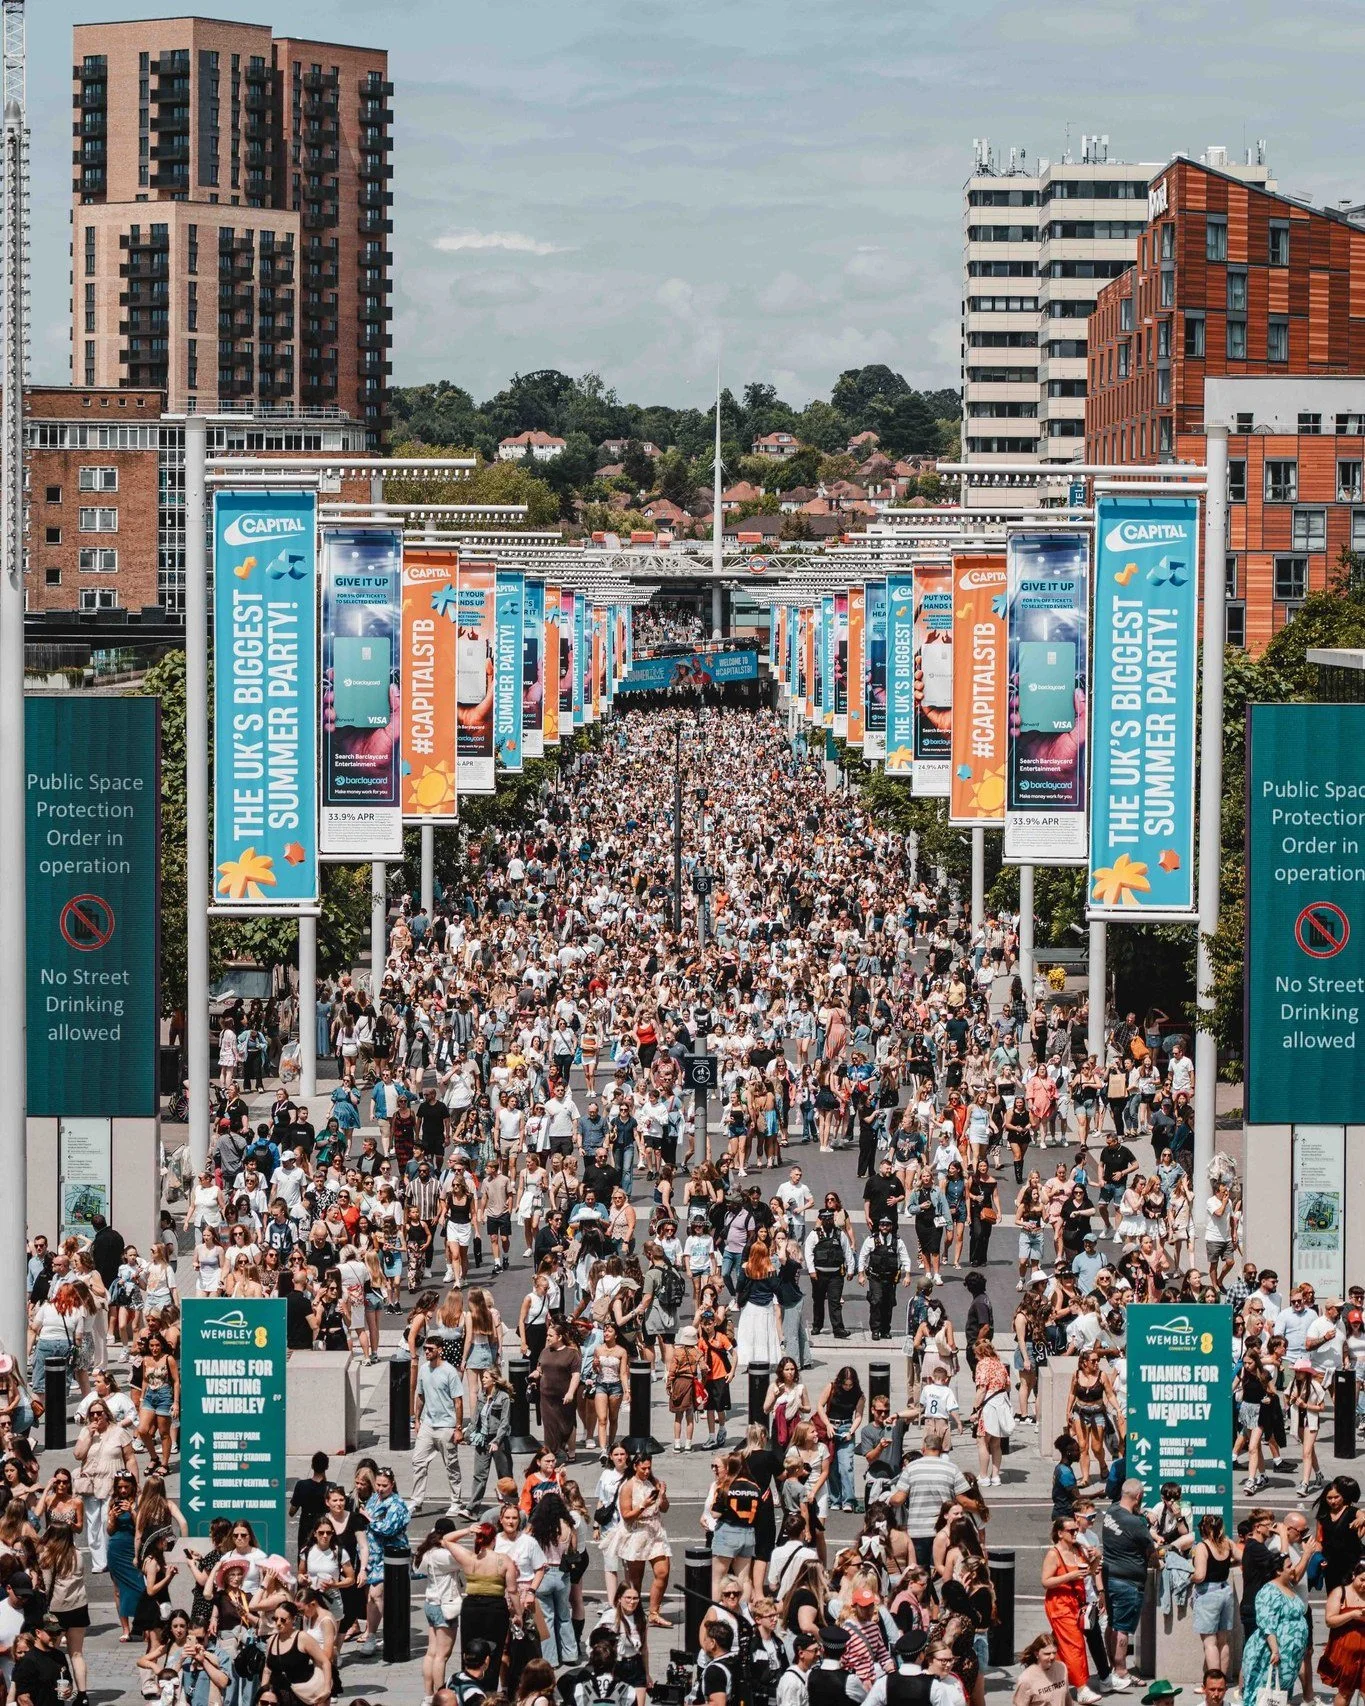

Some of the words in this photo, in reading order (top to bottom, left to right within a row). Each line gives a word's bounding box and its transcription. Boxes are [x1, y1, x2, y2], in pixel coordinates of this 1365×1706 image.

[242, 518, 305, 533] CAPITAL
[1124, 524, 1187, 539] CAPITAL
[335, 578, 360, 586] GIVE
[362, 578, 372, 586] IT
[374, 578, 388, 586] UP
[410, 568, 451, 579] CAPITAL
[970, 572, 1006, 582] CAPITA
[1021, 583, 1046, 591] GIVE
[1048, 583, 1058, 591] IT
[1060, 583, 1074, 591] UP
[232, 589, 264, 704] BIGGEST
[267, 602, 299, 697] PARTY!
[499, 625, 515, 671] PARTY!
[895, 622, 911, 677] BIGGEST
[1111, 595, 1144, 711] BIGGEST
[719, 657, 742, 667] WELCOME
[742, 656, 748, 665] TO
[1146, 608, 1179, 707] PARTY!
[410, 618, 435, 755] #CAPITALSTB
[970, 622, 997, 760] #CAPITALSTB
[498, 675, 514, 735] SUMMER
[368, 716, 387, 724] VISA
[1053, 721, 1072, 729] VISA
[895, 716, 911, 743] THE
[232, 714, 264, 779] UK'S
[1109, 720, 1142, 786] UK'S
[267, 707, 299, 829] SUMMER
[1144, 713, 1176, 836] SUMMER
[27, 774, 83, 791] Public
[89, 774, 144, 794] Space
[345, 777, 388, 785] barclaycard
[1030, 782, 1073, 790] barclaycard
[1263, 781, 1319, 798] Public
[1325, 781, 1365, 801] Spac
[36, 801, 134, 818] Protection
[232, 789, 264, 841] THE
[328, 813, 356, 821] 33.9%
[357, 813, 375, 821] APR
[1109, 795, 1141, 847] THE
[46, 829, 101, 846] Order
[107, 829, 123, 846] in
[1282, 837, 1337, 854] Order
[1343, 837, 1358, 854] in
[39, 858, 130, 877] operation
[1274, 865, 1365, 883] operation
[41, 969, 67, 985] No
[73, 969, 130, 985] Street
[1276, 976, 1302, 993] No
[1308, 976, 1364, 993] Street
[46, 996, 124, 1016] Drinking
[1280, 1004, 1359, 1024] Drinking
[48, 1024, 120, 1041] allowed
[1282, 1032, 1355, 1049] allowed
[200, 1330, 253, 1339] WEMBLEY
[1146, 1335, 1198, 1345] WEMBLEY
[194, 1359, 246, 1376] THANKS
[248, 1359, 273, 1376] FOR
[1140, 1365, 1191, 1382] THANKS
[1194, 1365, 1219, 1382] FOR
[206, 1378, 261, 1395] VISITING
[1151, 1384, 1207, 1401] VISITING
[201, 1397, 266, 1414] WEMBLEY
[930, 1400, 938, 1414] 8
[1147, 1403, 1212, 1420] WEMBLEY
[213, 1431, 243, 1440] WEMBLEY
[243, 1431, 260, 1440] PARK
[1159, 1438, 1189, 1447] WEMBLEY
[1190, 1438, 1207, 1447] PARK
[213, 1441, 238, 1449] STATION
[1159, 1447, 1185, 1455] STATION
[213, 1453, 243, 1462] WEMBLEY
[243, 1453, 271, 1462] STADIUM
[213, 1462, 238, 1470] STATION
[1159, 1459, 1189, 1468] WEMBLEY
[1190, 1459, 1218, 1468] STADIUM
[1159, 1468, 1185, 1477] STATION
[213, 1479, 243, 1487] WEMBLEY
[243, 1479, 270, 1487] CENTRAL
[1190, 1485, 1217, 1494] CENTRAL
[213, 1500, 231, 1508] EVENT
[232, 1500, 245, 1508] DAY
[245, 1500, 259, 1508] TAXI
[259, 1500, 277, 1508] RANK
[1192, 1506, 1206, 1515] TAXI
[1206, 1506, 1224, 1515] RANK
